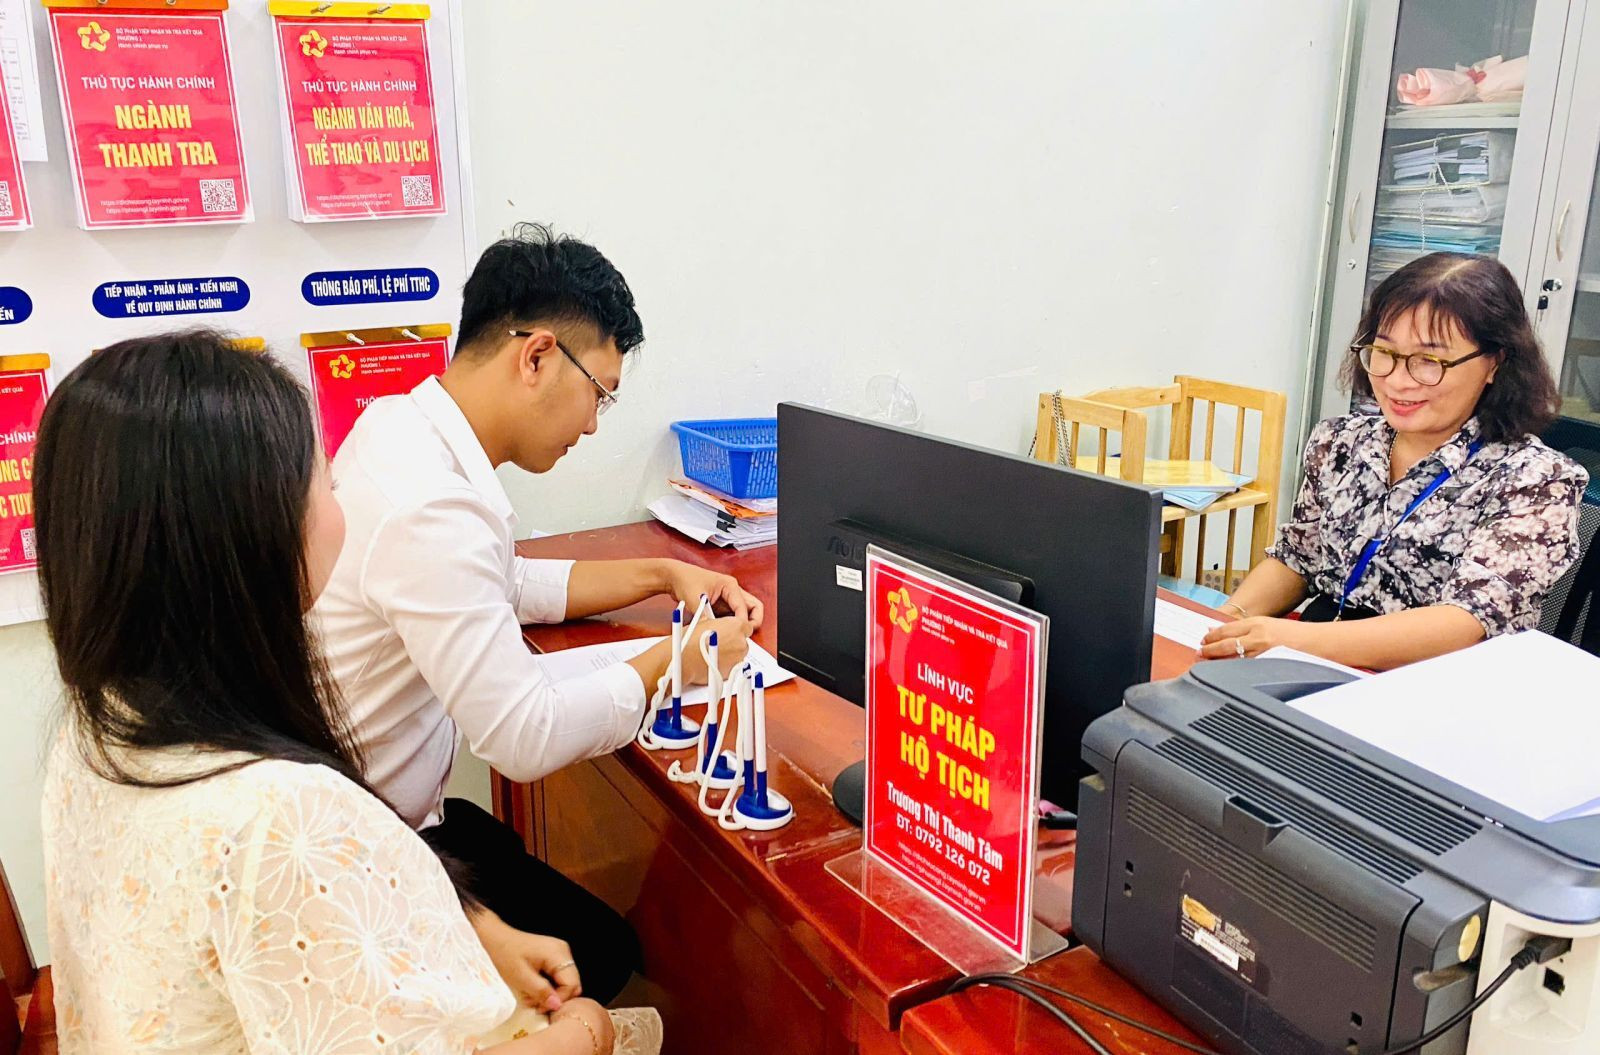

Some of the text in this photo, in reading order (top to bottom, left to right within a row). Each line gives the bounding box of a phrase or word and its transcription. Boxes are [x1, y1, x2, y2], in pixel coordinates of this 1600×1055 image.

[81, 74, 215, 91] THỦ TỤC HÀNH CHÍNH
[302, 78, 417, 94] THỦ TỤC HÀNH CHÍNH
[114, 100, 192, 130] NGÀNH
[312, 101, 415, 130] NGÀNH VĂN HOÁ,
[99, 141, 218, 168] THANH TRA
[305, 134, 429, 167] THỂ THAO VÀ DU LỊCH
[104, 284, 123, 298] TIẾP
[124, 285, 147, 299] NHẬN
[153, 281, 176, 296] PHẢN
[177, 281, 194, 295] ÁNH
[200, 279, 218, 293] KIẾN
[219, 281, 238, 294] NGHỊ
[311, 274, 431, 297] THÔNG BÁO PHÍ, LỆ PHÍ TTHC
[138, 301, 154, 314] QUY
[155, 300, 174, 314] ĐỊNH
[175, 298, 197, 311] HÀNH
[198, 297, 222, 310] CHÍNH
[917, 662, 974, 705] LĨNH VỰC
[896, 684, 996, 762] TƯ PHÁP
[900, 730, 990, 811] HỘ TỊCH
[896, 812, 991, 886] ĐT: 0792 126 072
[923, 803, 940, 836] Thị
[942, 815, 975, 855] Thanh
[977, 837, 1003, 872] Tâm
